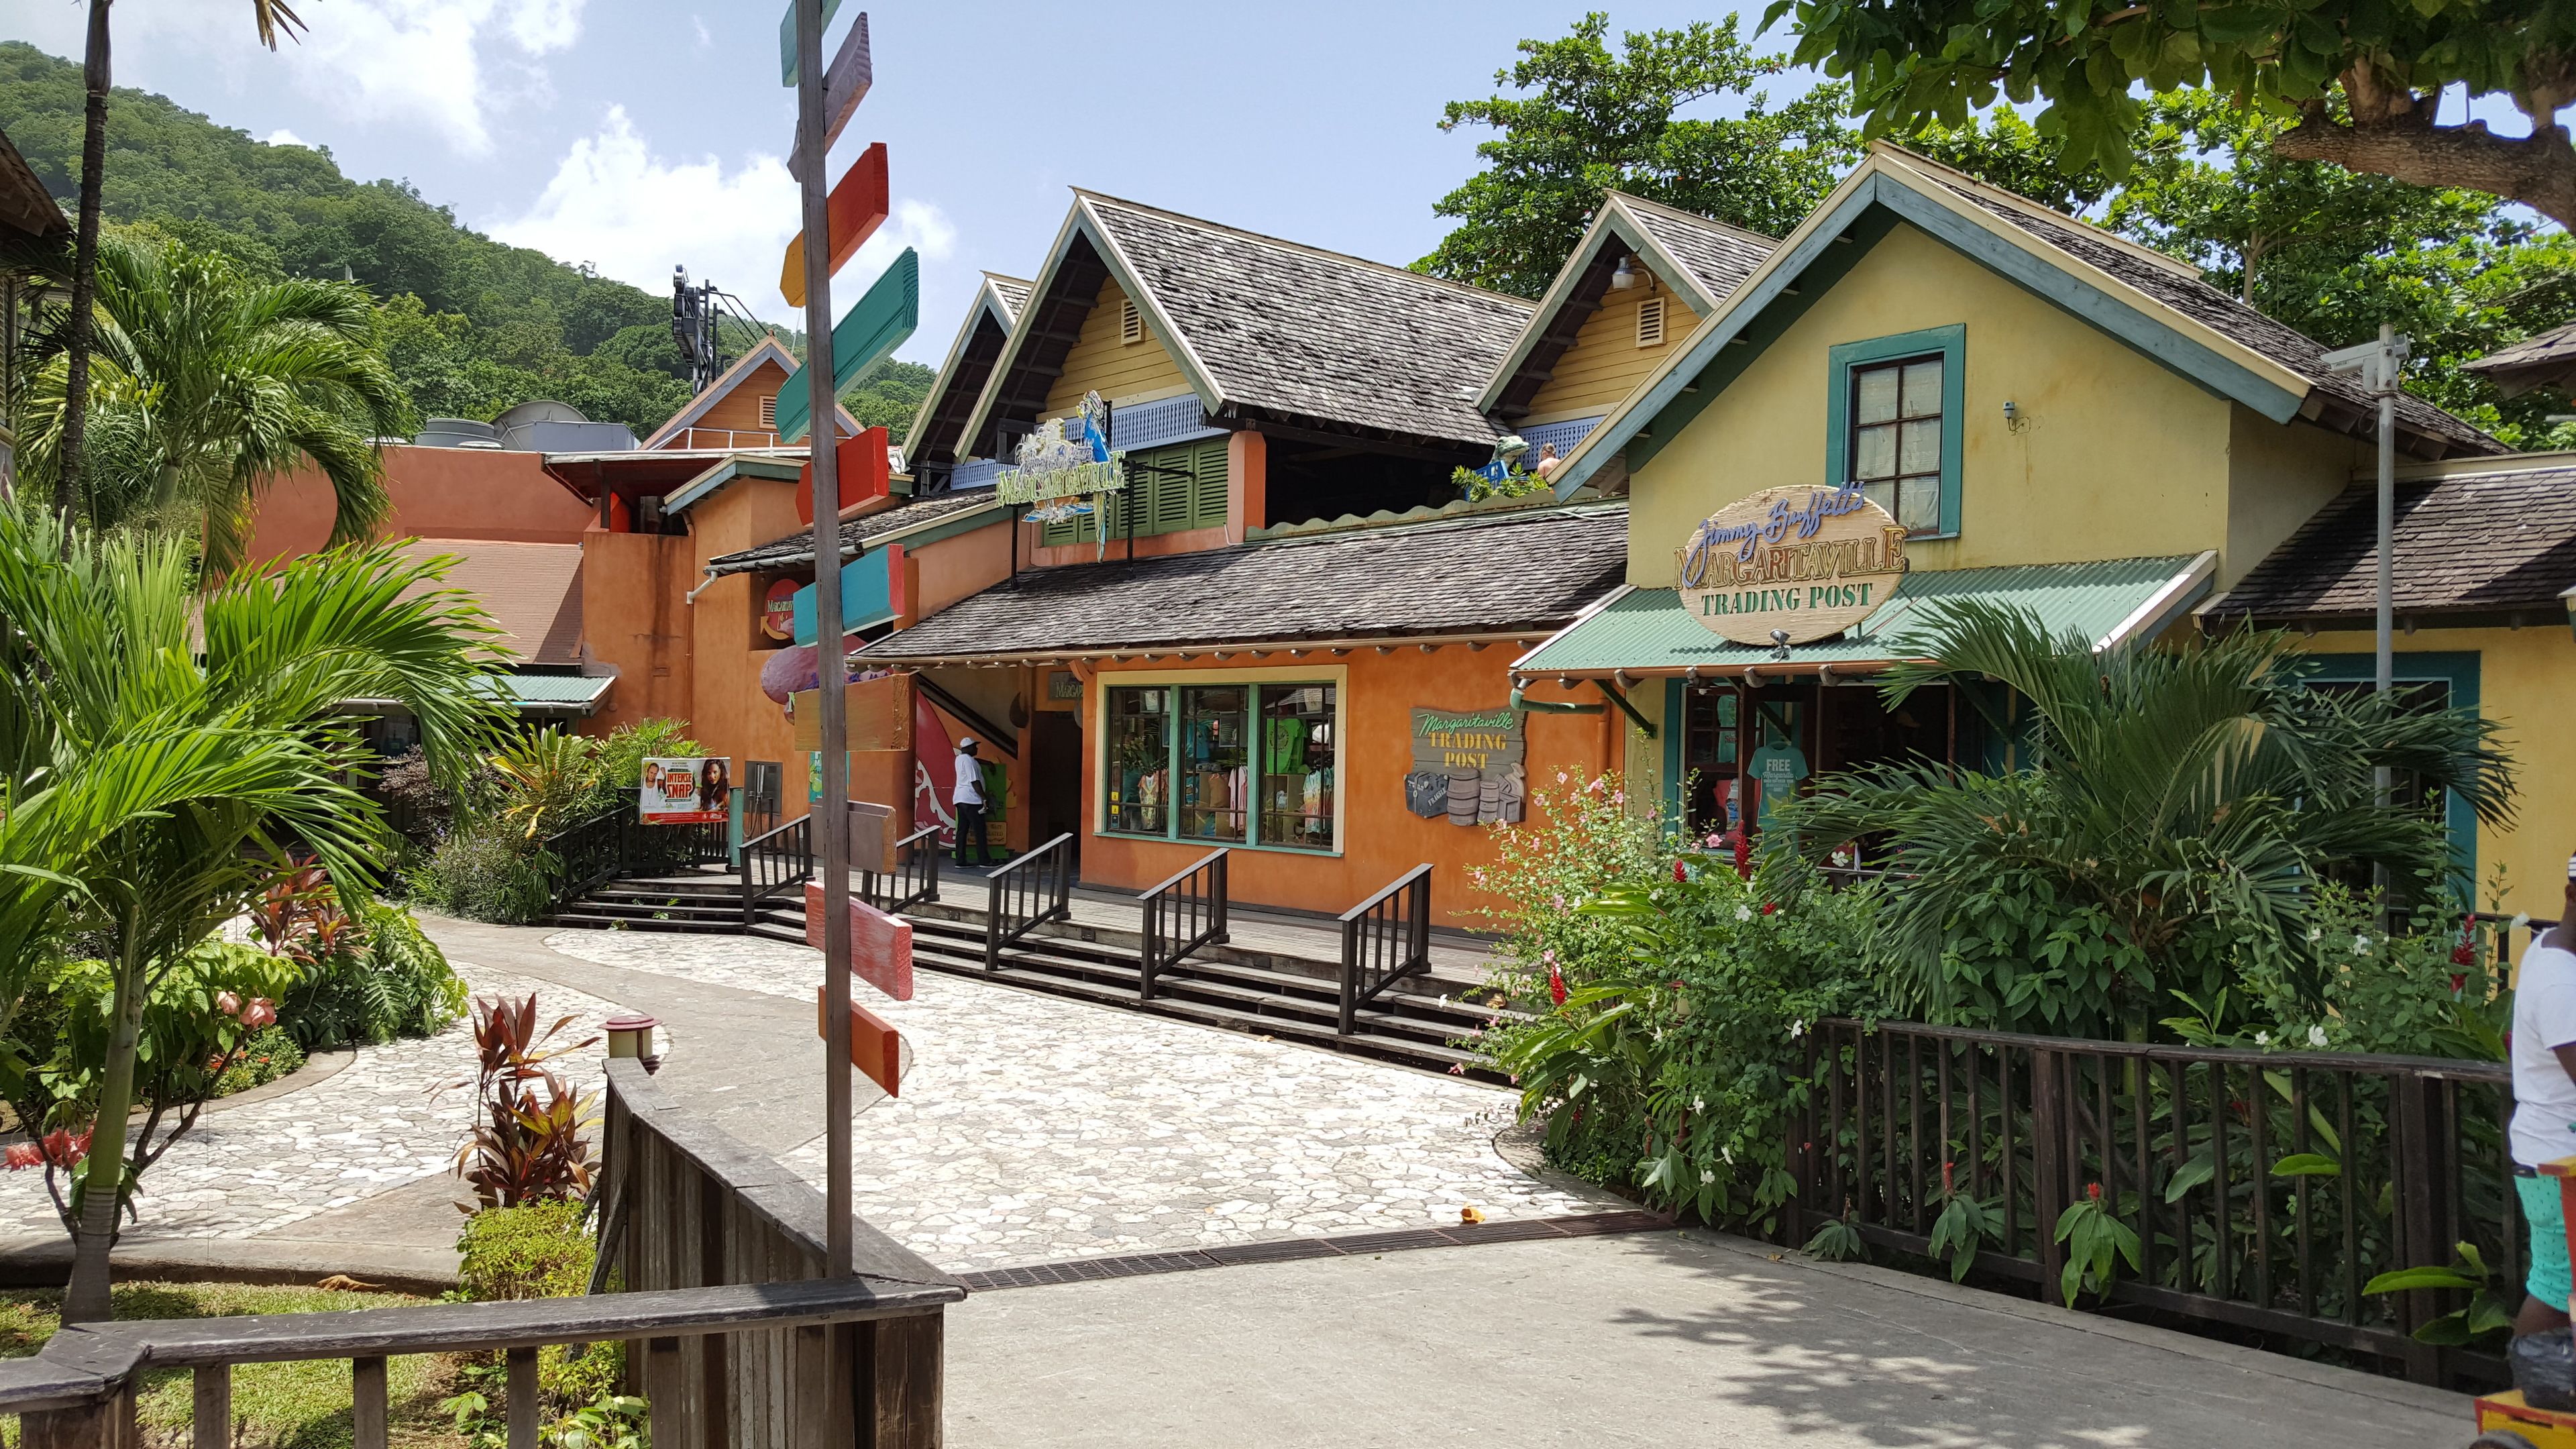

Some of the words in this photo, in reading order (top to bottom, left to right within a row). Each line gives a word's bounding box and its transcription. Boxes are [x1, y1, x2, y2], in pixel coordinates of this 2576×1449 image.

[1673, 525, 1907, 590] MARGARITAVILLE
[1682, 518, 1763, 588] Jimmy
[1701, 587, 1801, 616] TRADING
[1809, 583, 1873, 609] POST
[1416, 712, 1514, 737] Margaritaville
[1428, 732, 1507, 751] TRADING
[1444, 751, 1489, 769] POST
[1766, 759, 1790, 771] FREE
[667, 773, 692, 783] INTENSE
[666, 784, 692, 798] SNAP
